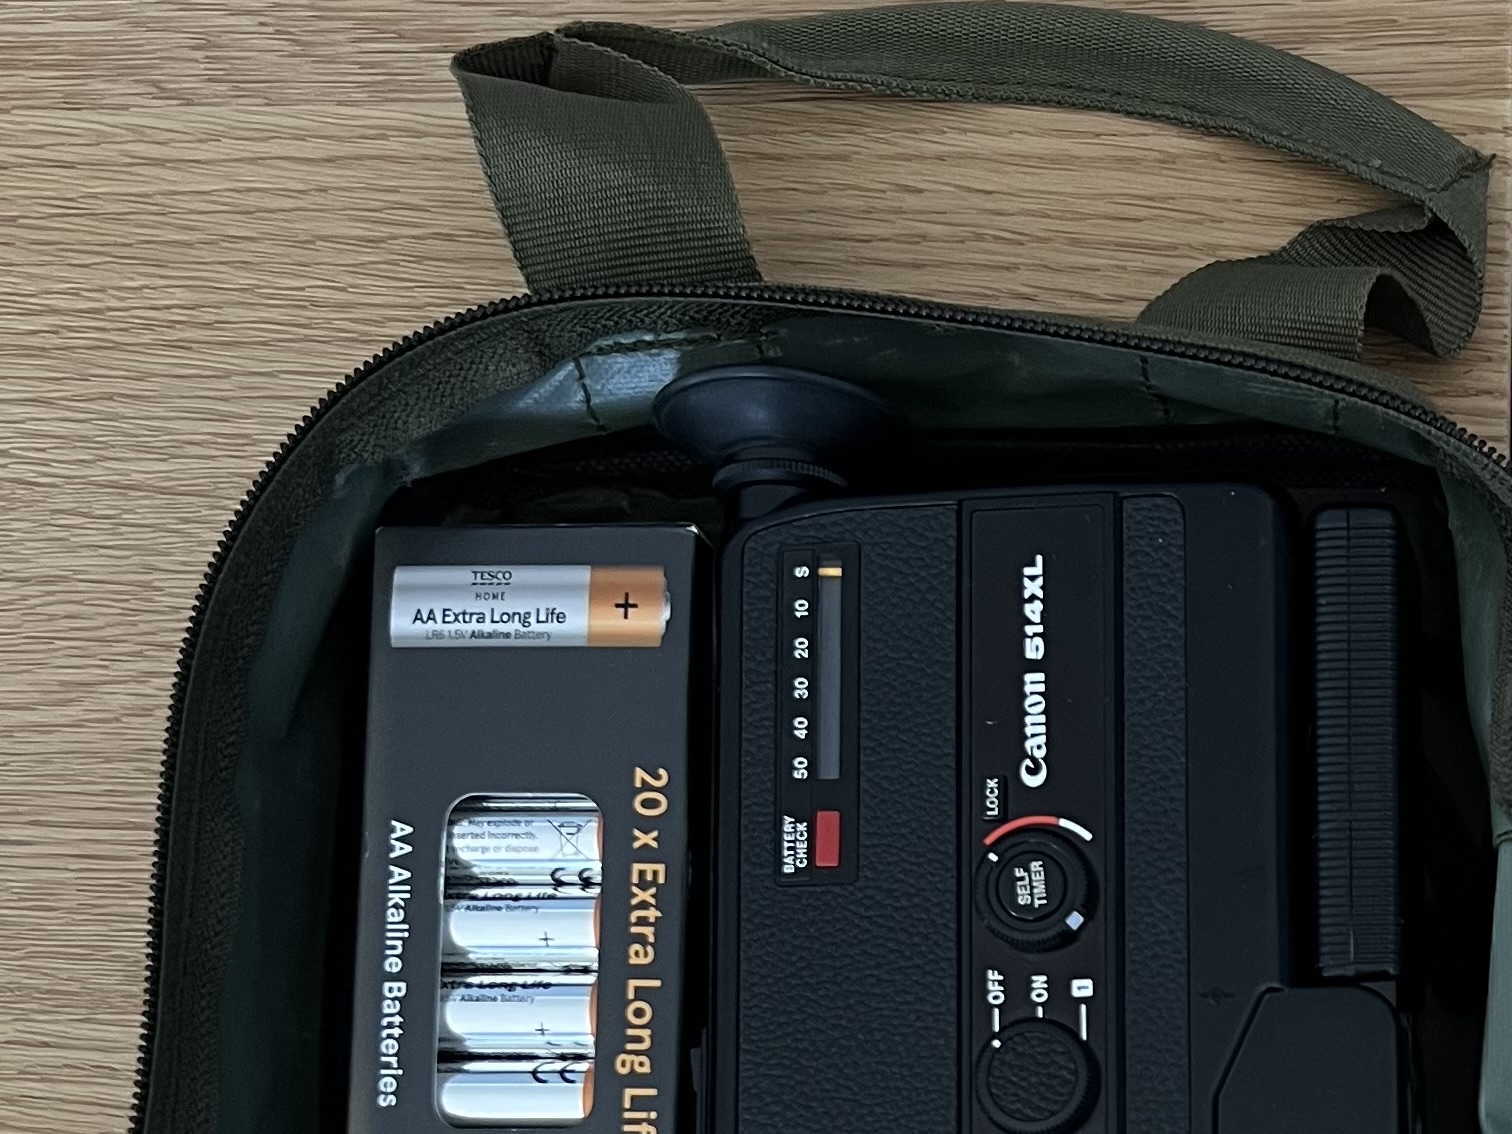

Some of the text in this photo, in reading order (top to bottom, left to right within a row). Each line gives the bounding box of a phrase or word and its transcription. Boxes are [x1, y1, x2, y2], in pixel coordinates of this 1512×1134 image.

[471, 570, 513, 581] TESCO
[794, 566, 810, 578] S
[475, 592, 506, 601] HOME
[793, 599, 809, 619] 10
[412, 607, 567, 627] AA Extra Long Life
[470, 629, 512, 640] Alkaline
[513, 629, 552, 641] Battery
[793, 637, 809, 659] 20
[1020, 554, 1048, 788] Canon 514XL
[793, 677, 809, 699] 30
[793, 717, 809, 739] 40
[791, 757, 809, 780] 50
[632, 766, 669, 817] 20
[985, 778, 999, 816] LOCK
[632, 828, 660, 849] x
[783, 815, 796, 874] BATTERY
[795, 822, 809, 868] CHECK
[1017, 866, 1031, 906] SELF
[1030, 860, 1048, 908] TIMER
[627, 862, 666, 965] Extra
[377, 820, 415, 1108] AA Alkaline Batteries
[986, 969, 1005, 1005] OFF
[1030, 975, 1049, 1003] ON
[615, 979, 662, 1076] Long
